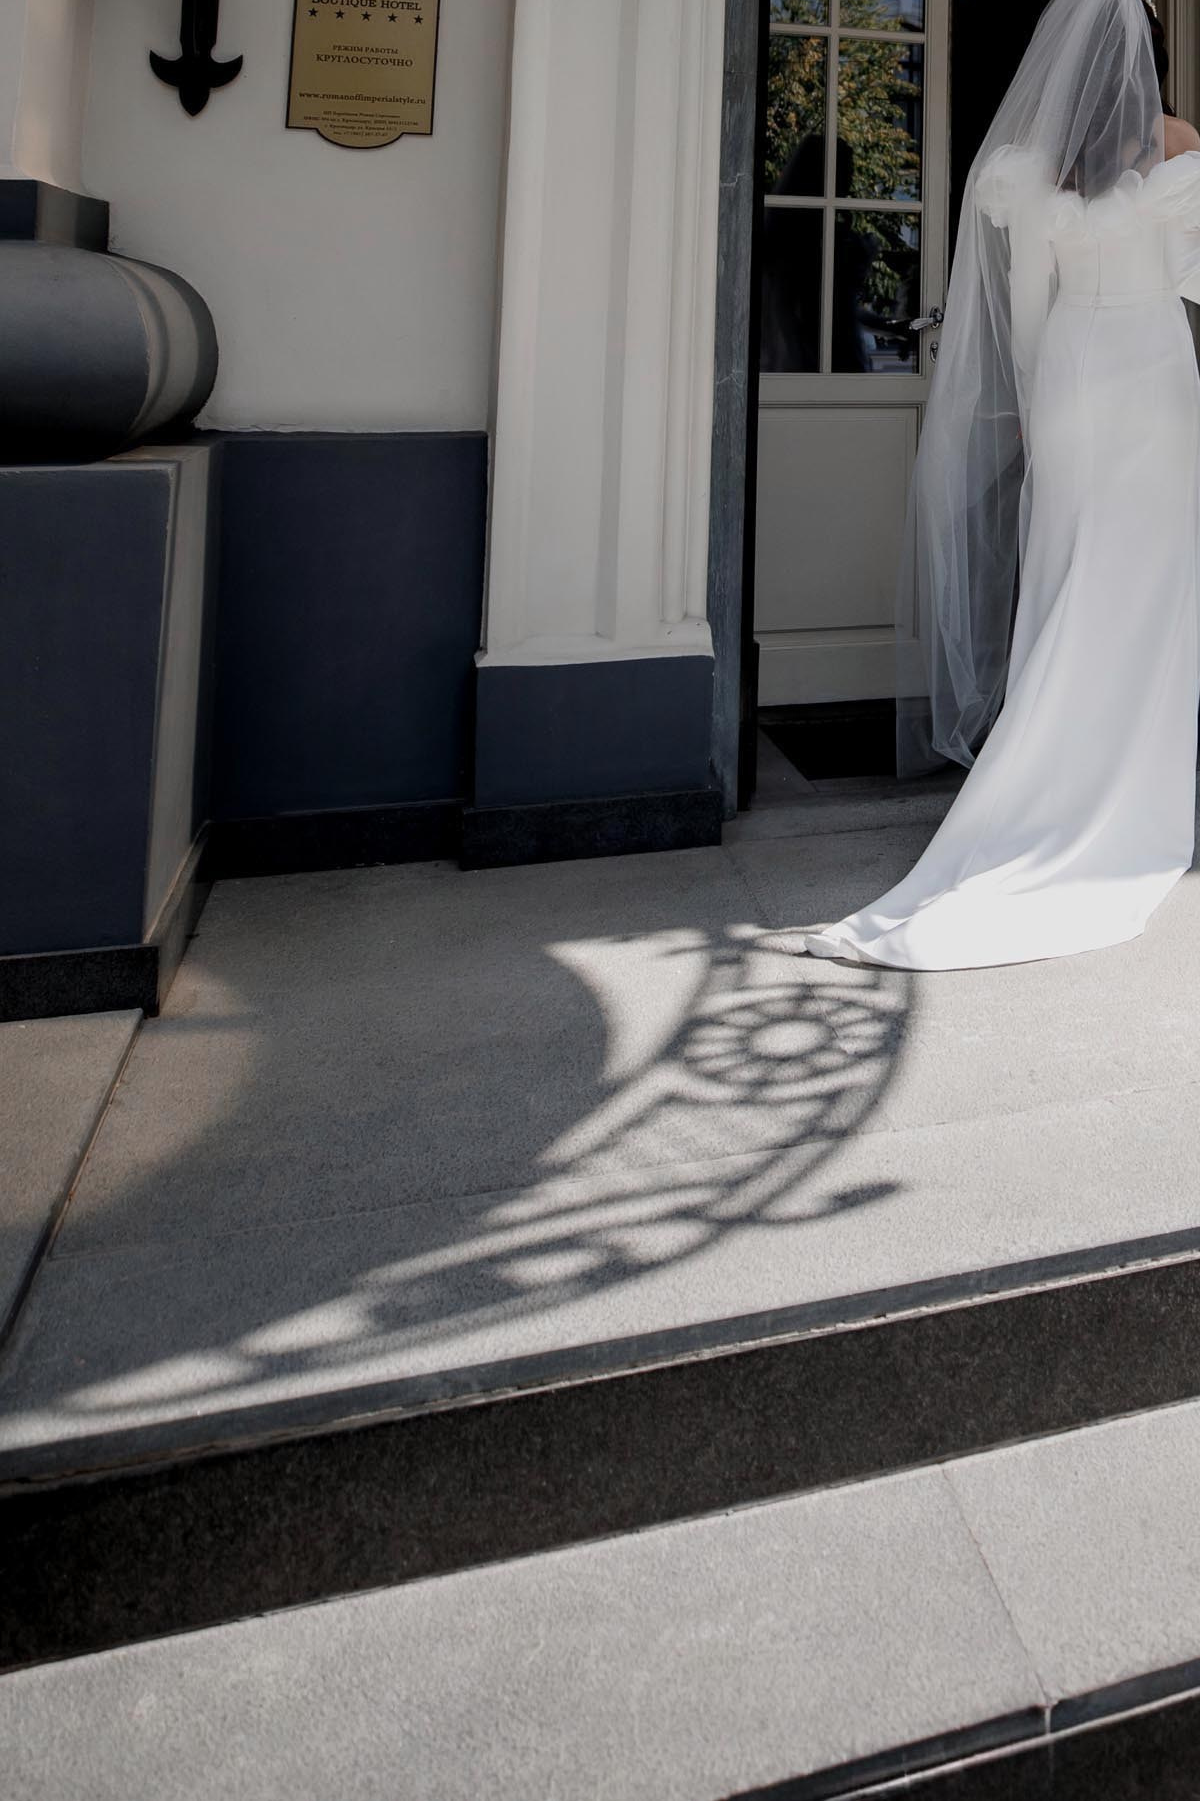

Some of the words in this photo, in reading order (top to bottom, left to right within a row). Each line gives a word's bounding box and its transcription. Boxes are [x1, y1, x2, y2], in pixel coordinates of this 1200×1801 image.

[381, 0, 422, 11] HOTEL
[332, 44, 363, 52] РЕЖИМ
[365, 46, 399, 54] РАБОТЫ
[316, 54, 413, 67] КРУГЛОСУТОЧНО
